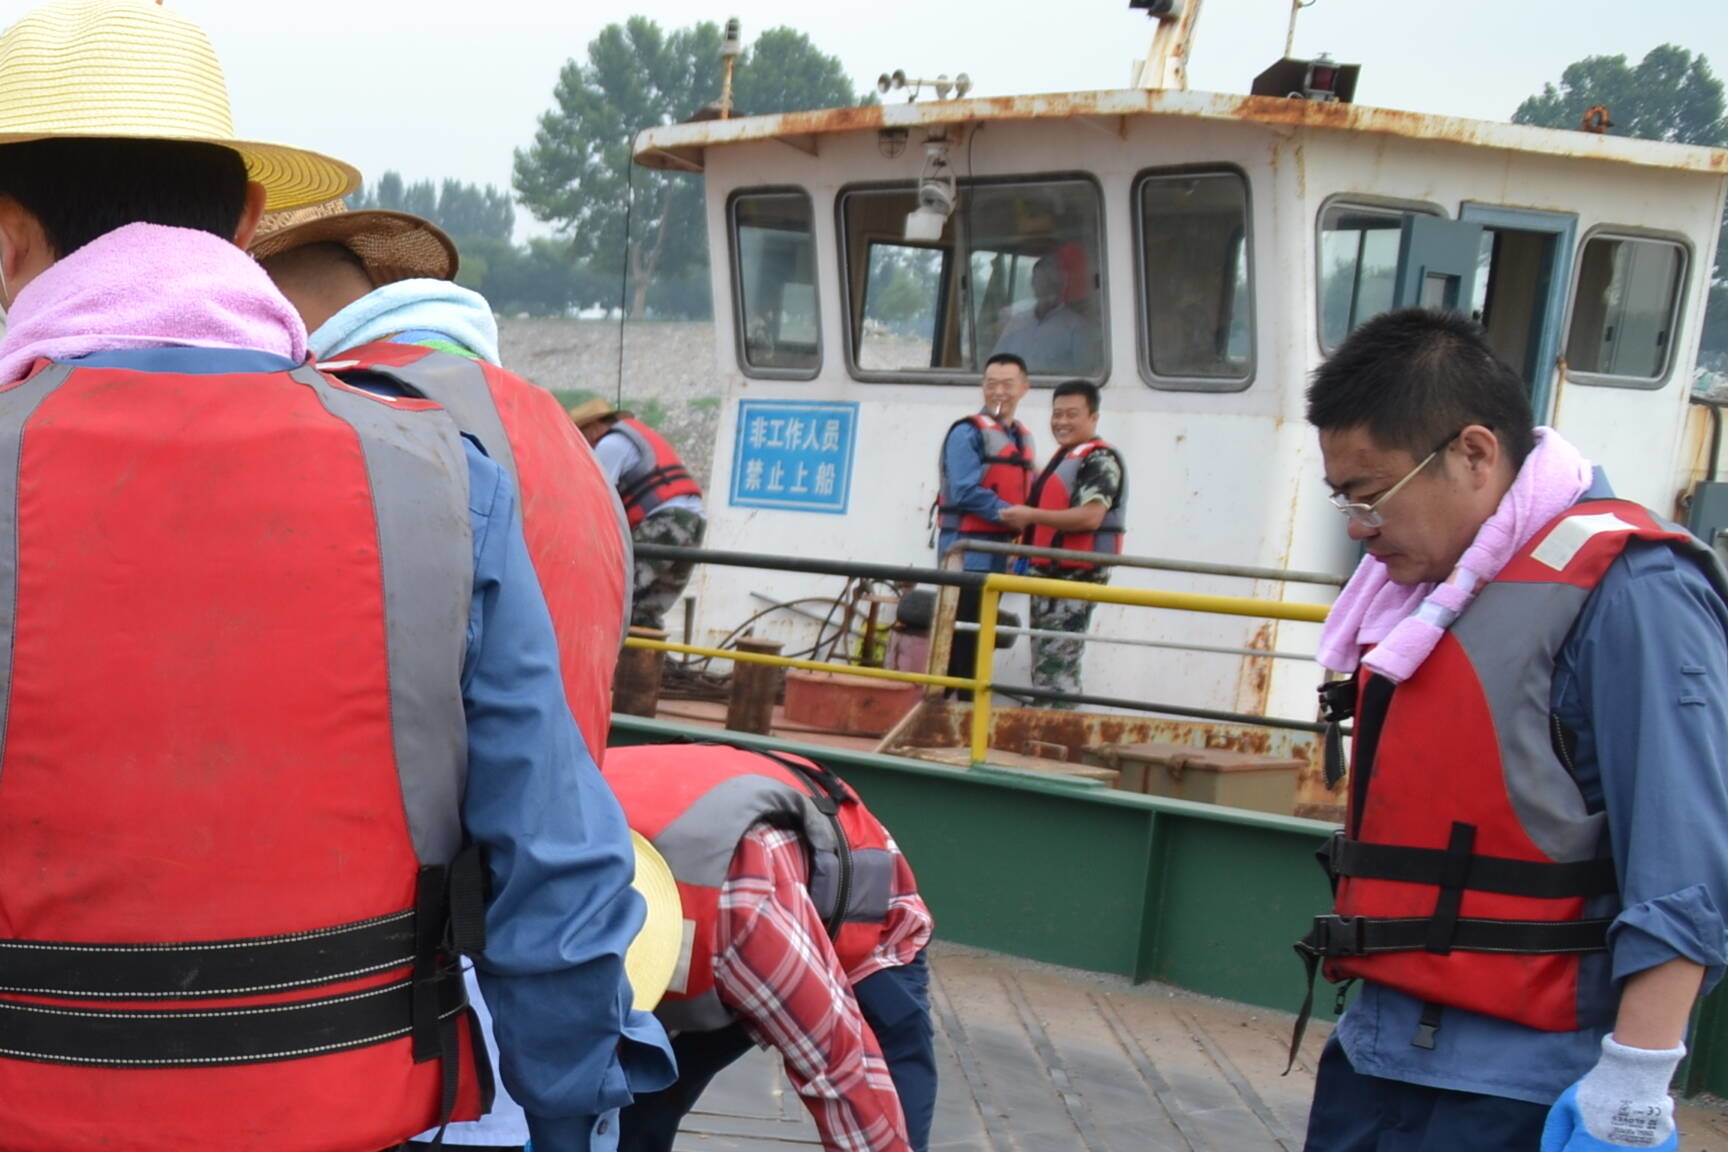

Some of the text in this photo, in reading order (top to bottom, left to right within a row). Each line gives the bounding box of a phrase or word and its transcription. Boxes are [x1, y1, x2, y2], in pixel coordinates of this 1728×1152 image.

[749, 415, 841, 453] 非工作人员
[744, 457, 837, 497] 禁止上船
